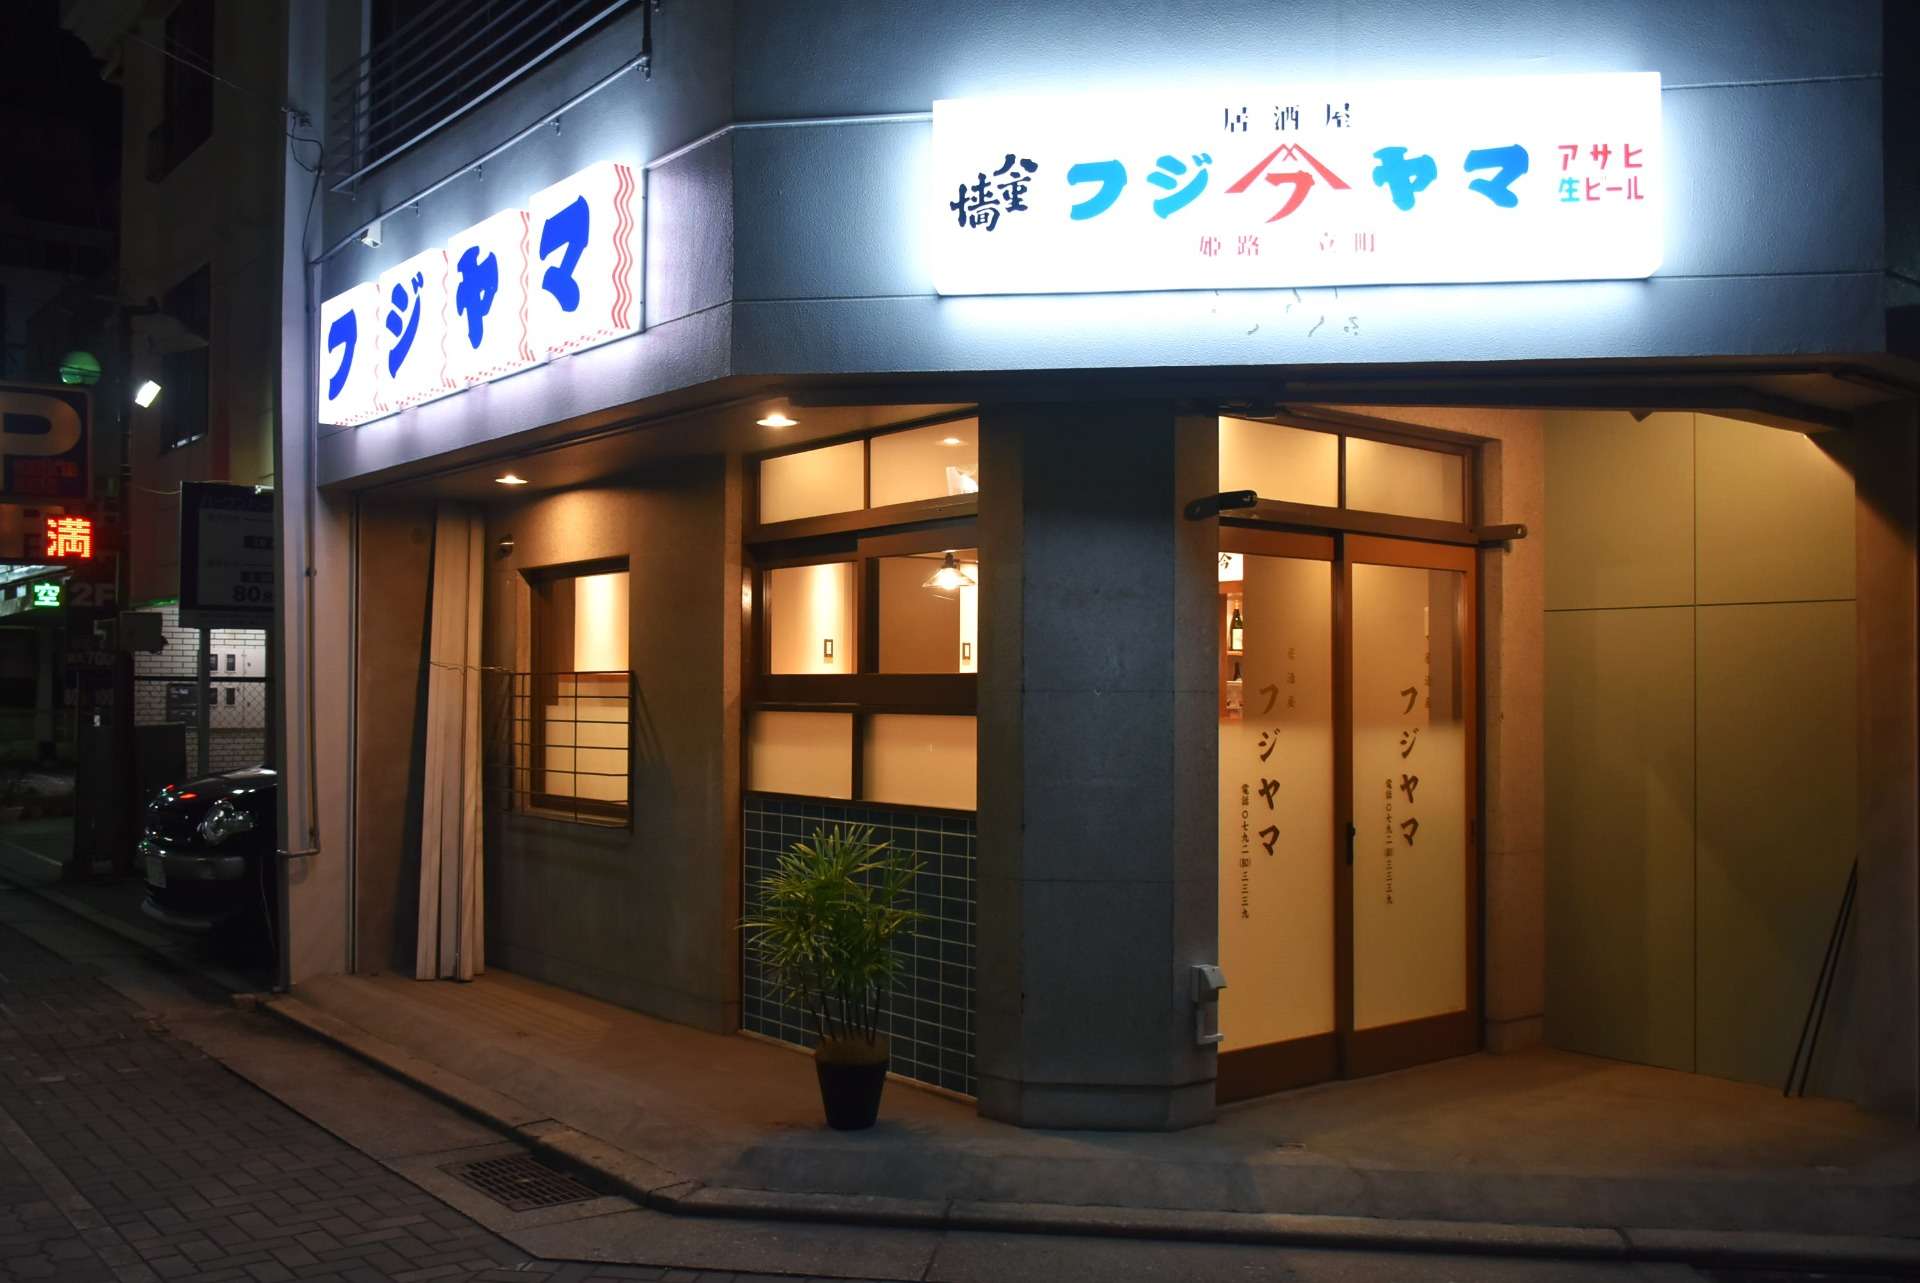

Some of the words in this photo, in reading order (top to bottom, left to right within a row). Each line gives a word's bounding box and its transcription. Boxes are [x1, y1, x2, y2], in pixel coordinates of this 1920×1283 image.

[1558, 143, 1644, 171] アサヒ
[1558, 175, 1645, 203] 生ビール
[328, 195, 590, 401] フジヤマ
[0, 391, 82, 492] P
[46, 516, 92, 559] 満
[33, 581, 61, 607] 空
[1257, 683, 1282, 857] フジヤマ
[1399, 686, 1420, 848] フジヤマ
